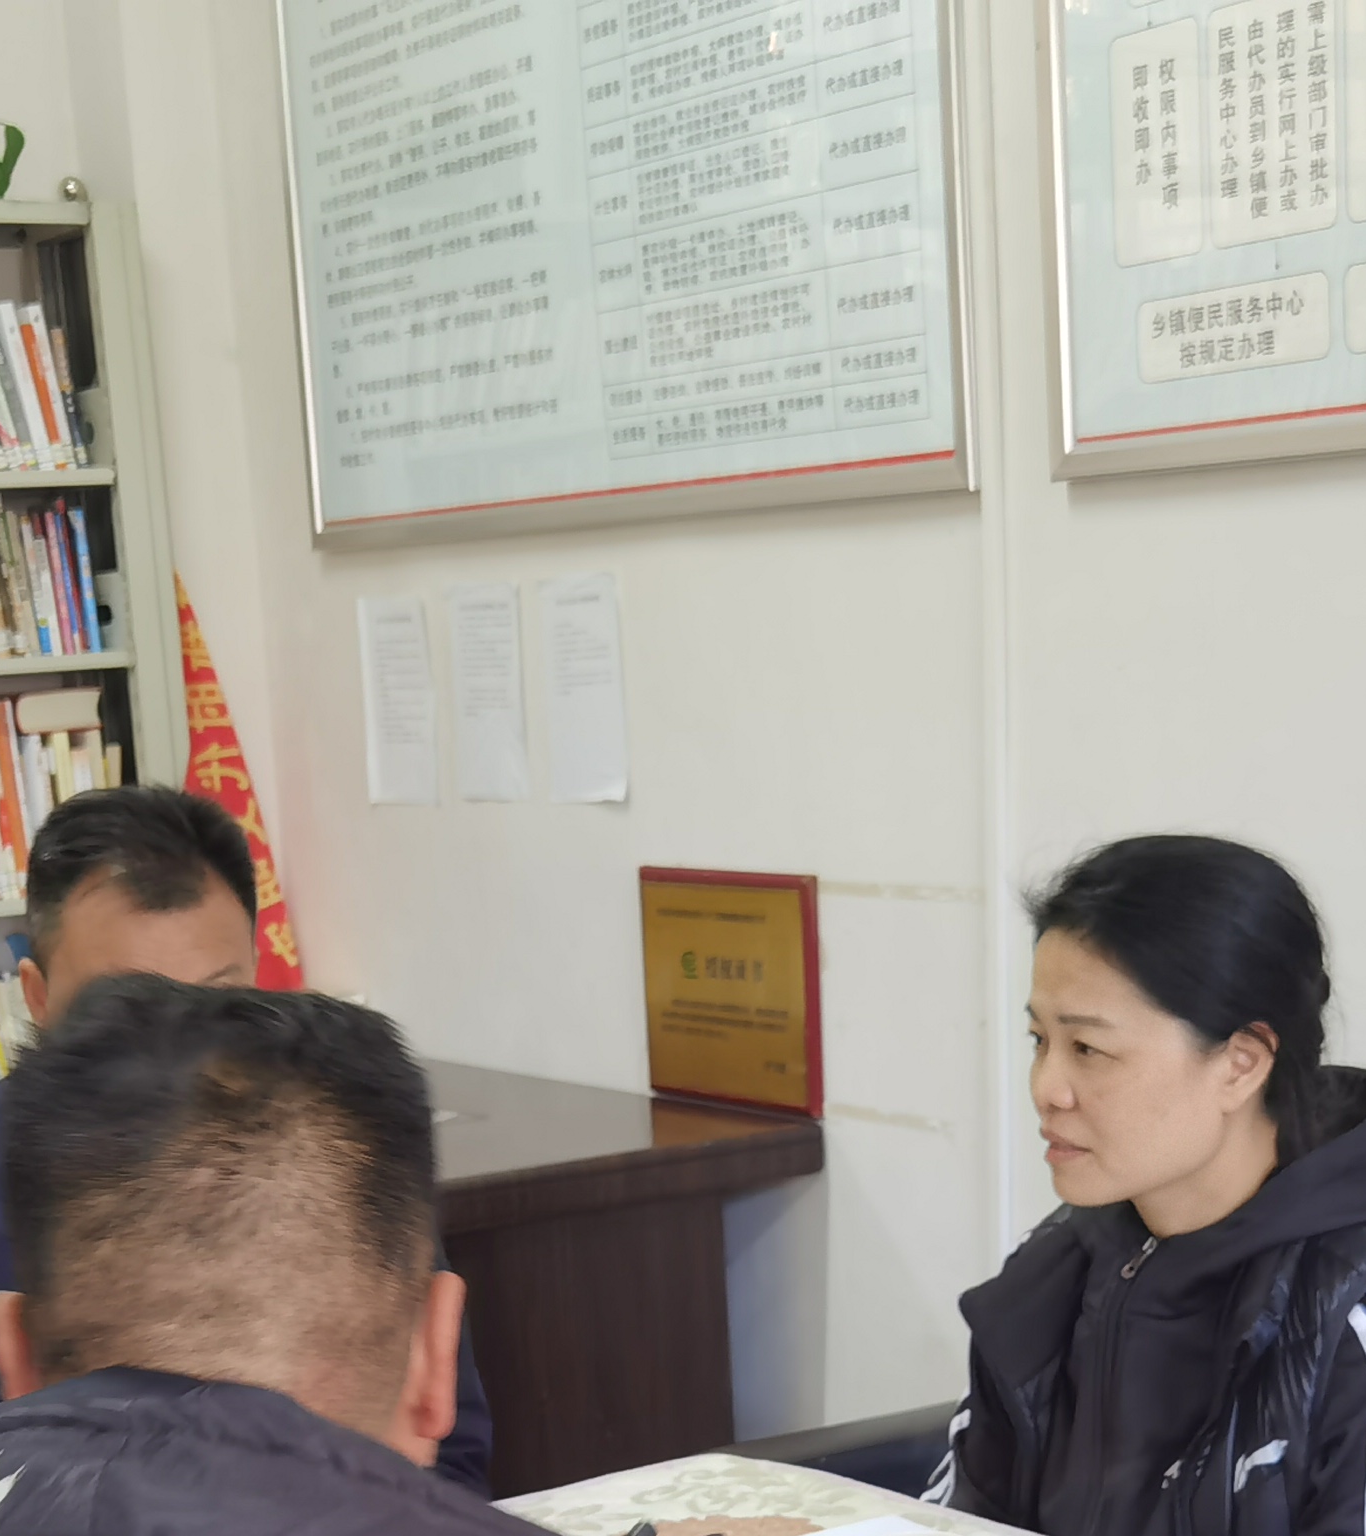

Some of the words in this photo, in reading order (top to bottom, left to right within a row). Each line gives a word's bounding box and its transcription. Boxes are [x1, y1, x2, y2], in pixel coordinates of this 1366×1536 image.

[1158, 58, 1179, 210] 权限内事项
[1217, 25, 1240, 200] 民服务中心办理
[1247, 18, 1269, 220] 由代办员到乡镇便
[1276, 8, 1298, 212] 理的实行网上办或
[1306, 0, 1329, 208] 需上级部门审批办
[1151, 289, 1306, 340] 乡镇便民服务中心
[1178, 330, 1276, 369] 按规定办理
